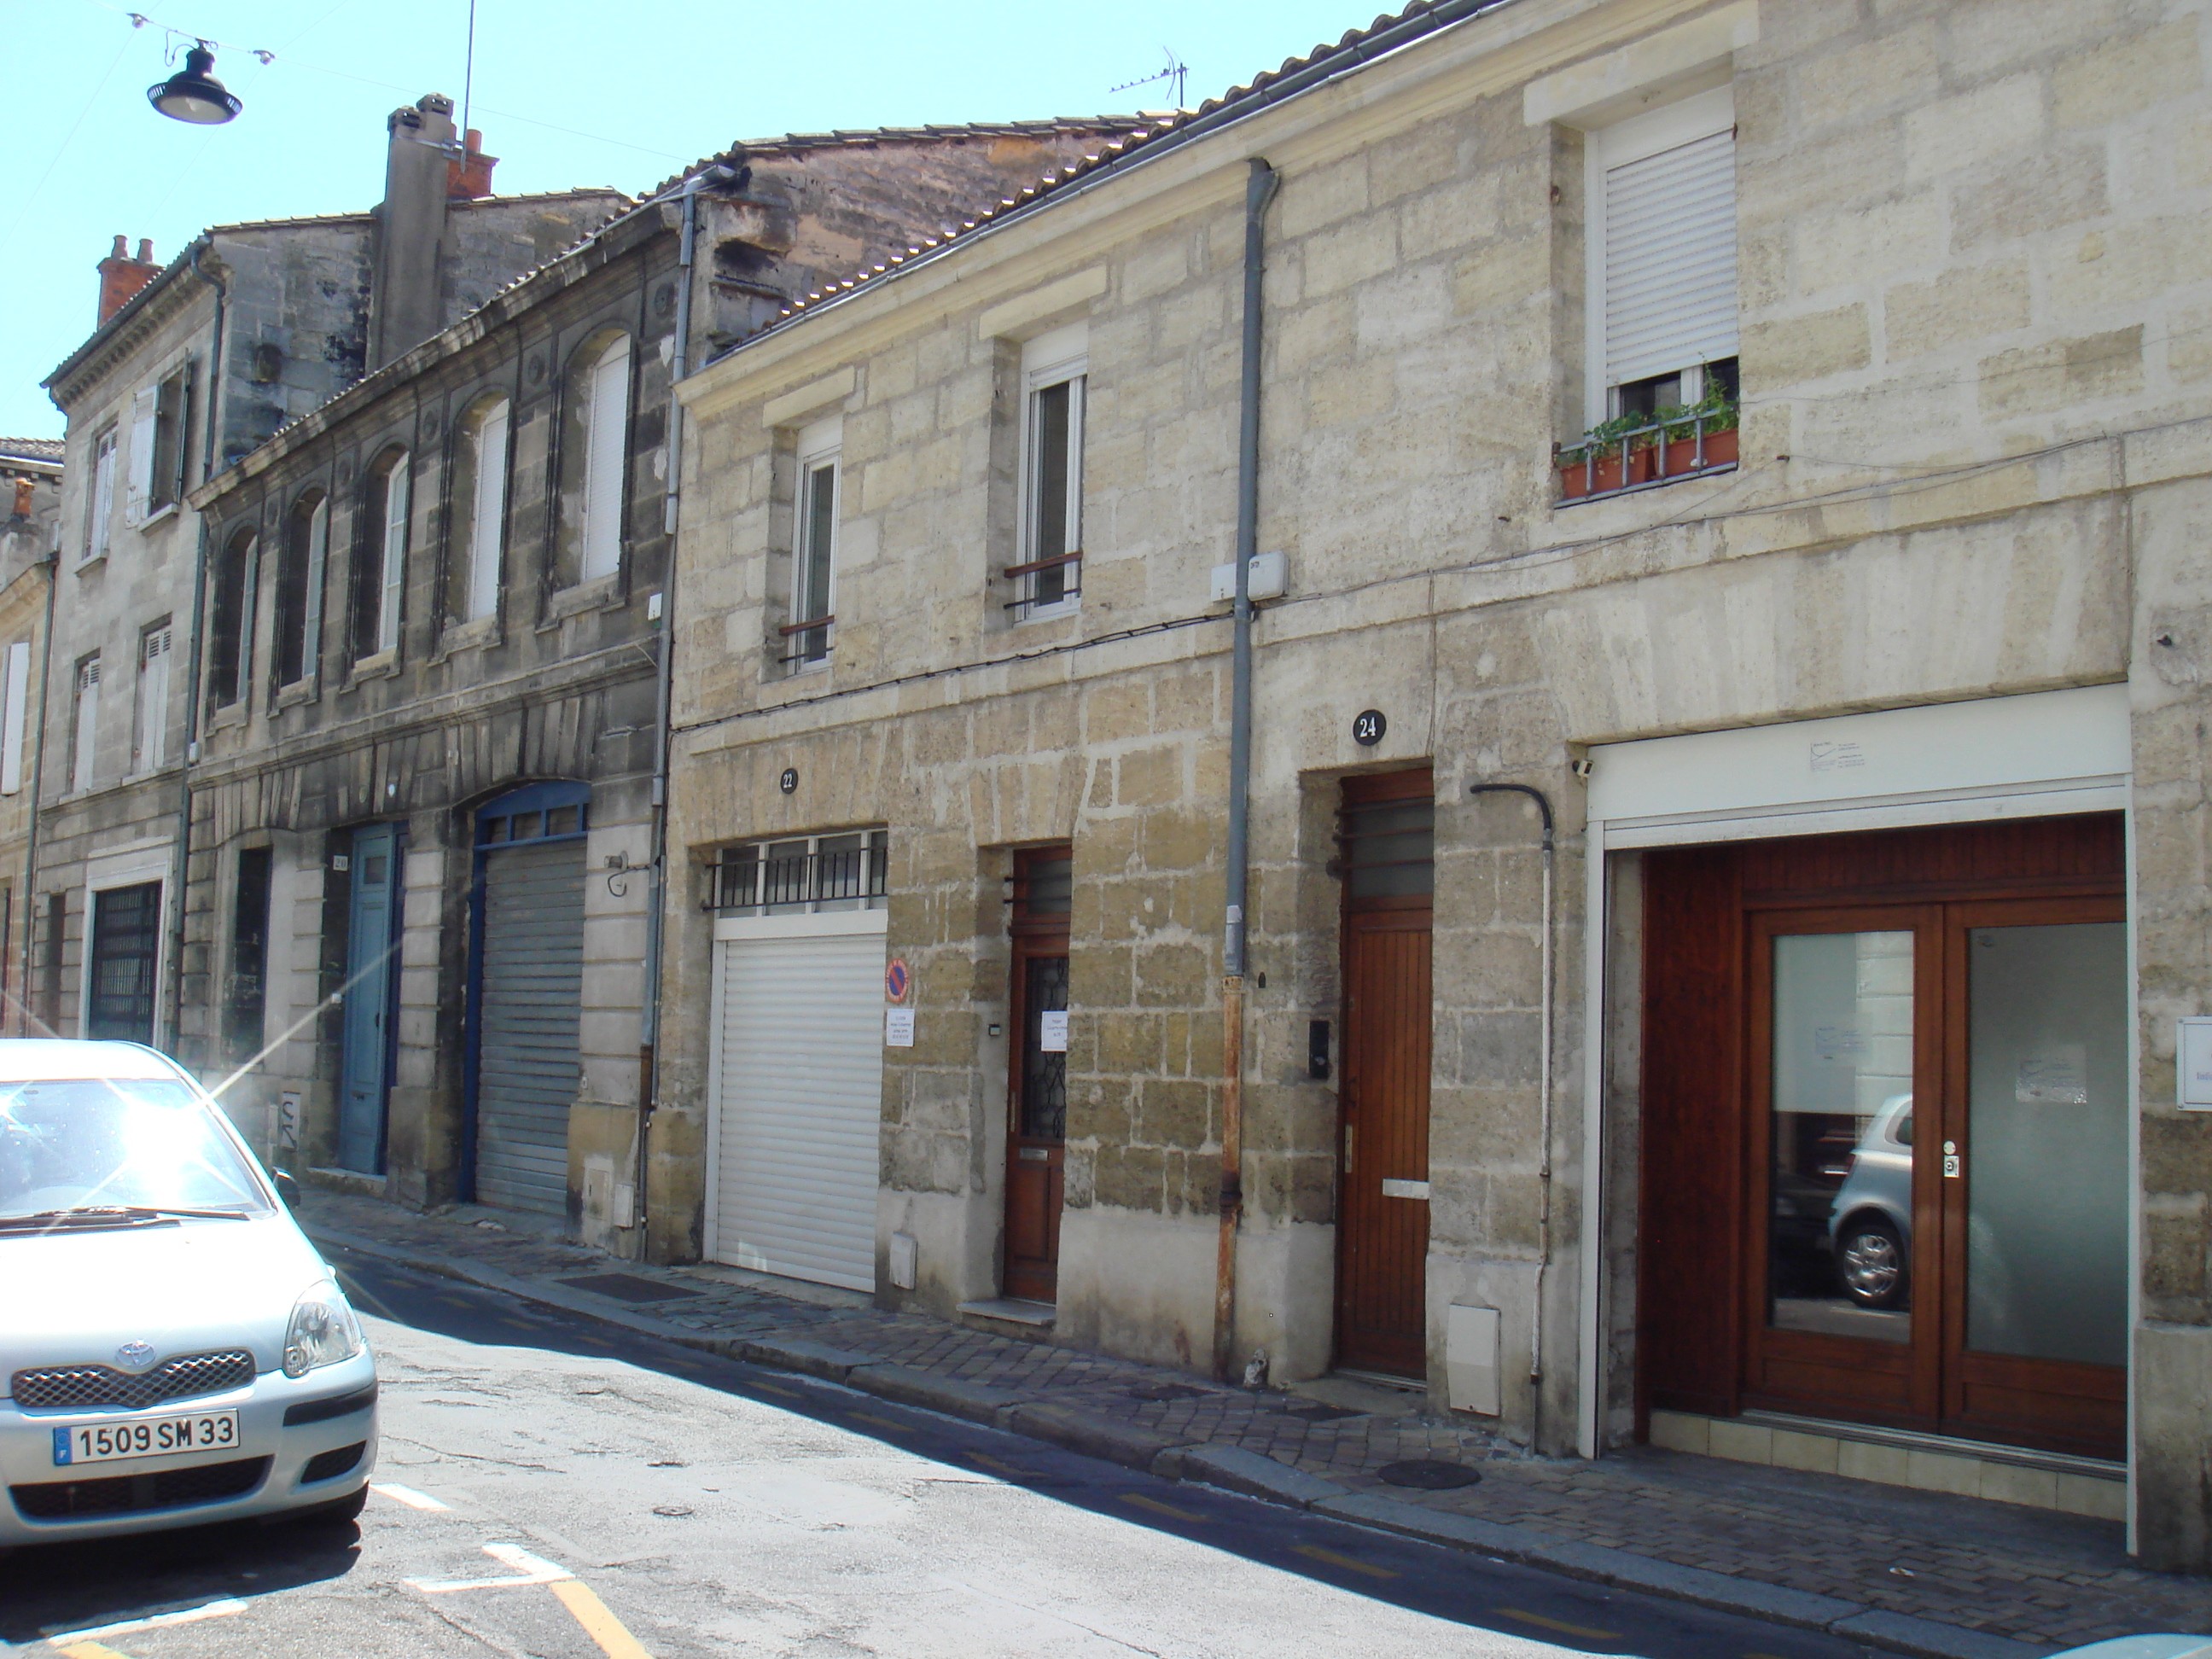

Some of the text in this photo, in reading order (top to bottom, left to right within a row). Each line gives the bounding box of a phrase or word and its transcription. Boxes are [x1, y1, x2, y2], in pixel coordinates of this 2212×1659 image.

[1359, 717, 1376, 737] 24
[783, 773, 793, 789] 22
[80, 1416, 234, 1456] 1509 SM 33
[60, 1449, 67, 1459] F
